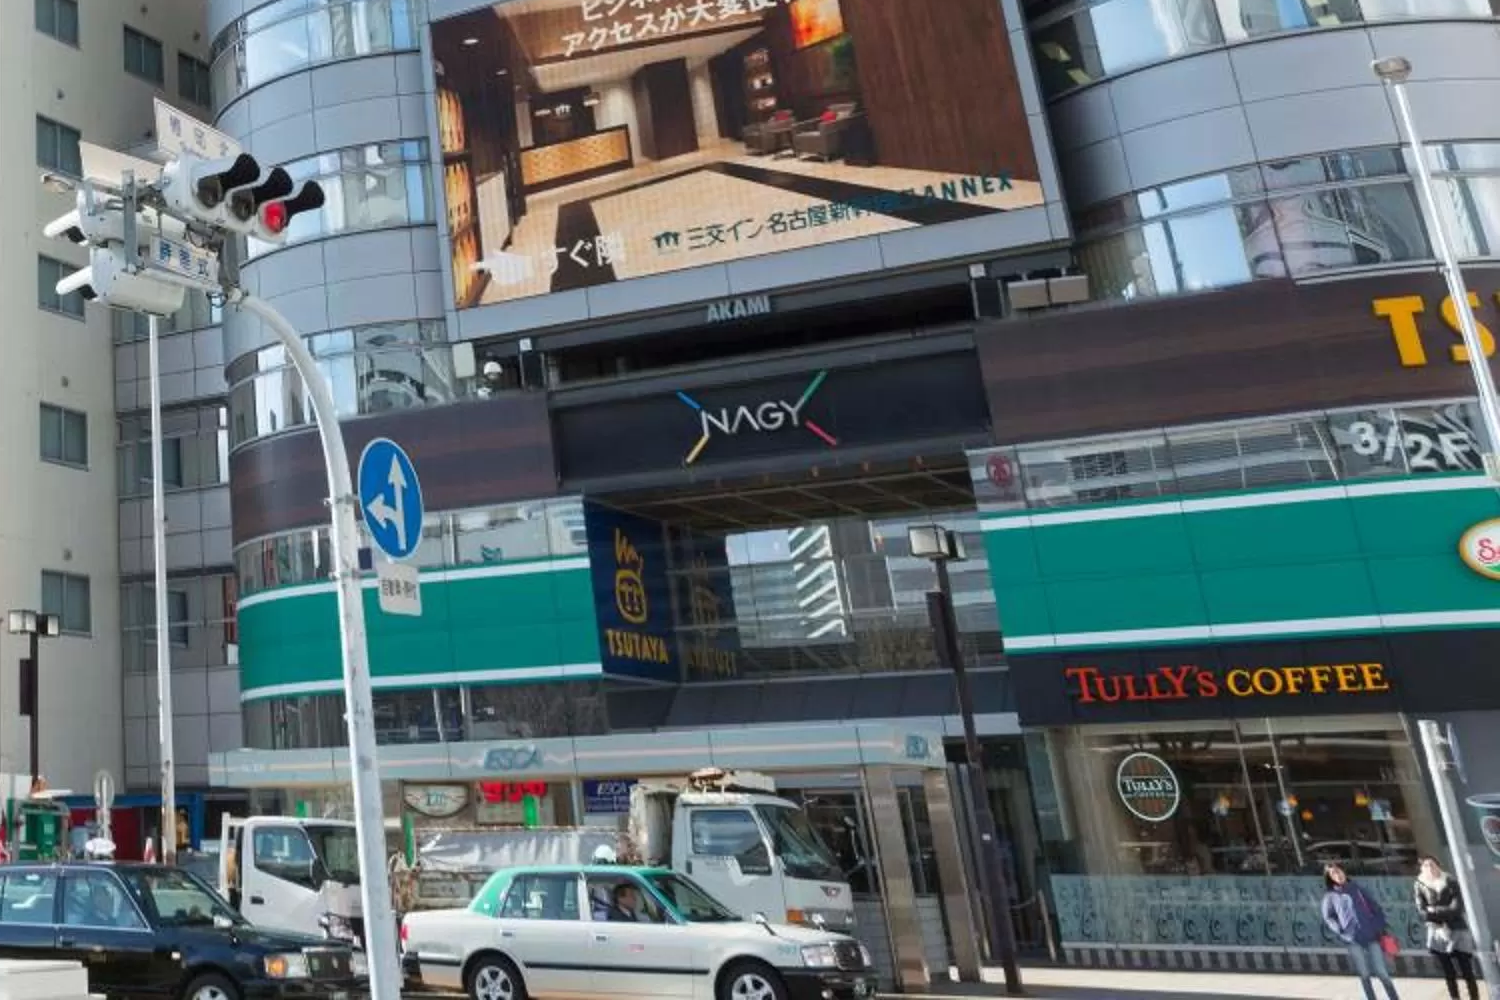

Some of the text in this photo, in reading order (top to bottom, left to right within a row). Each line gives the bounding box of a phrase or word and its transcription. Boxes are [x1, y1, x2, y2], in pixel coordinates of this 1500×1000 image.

[542, 232, 624, 275] すぐ隣
[1372, 291, 1500, 367] TS
[607, 628, 669, 664] TSUTAYA
[1066, 663, 1389, 703] TULLY'S COFFEE
